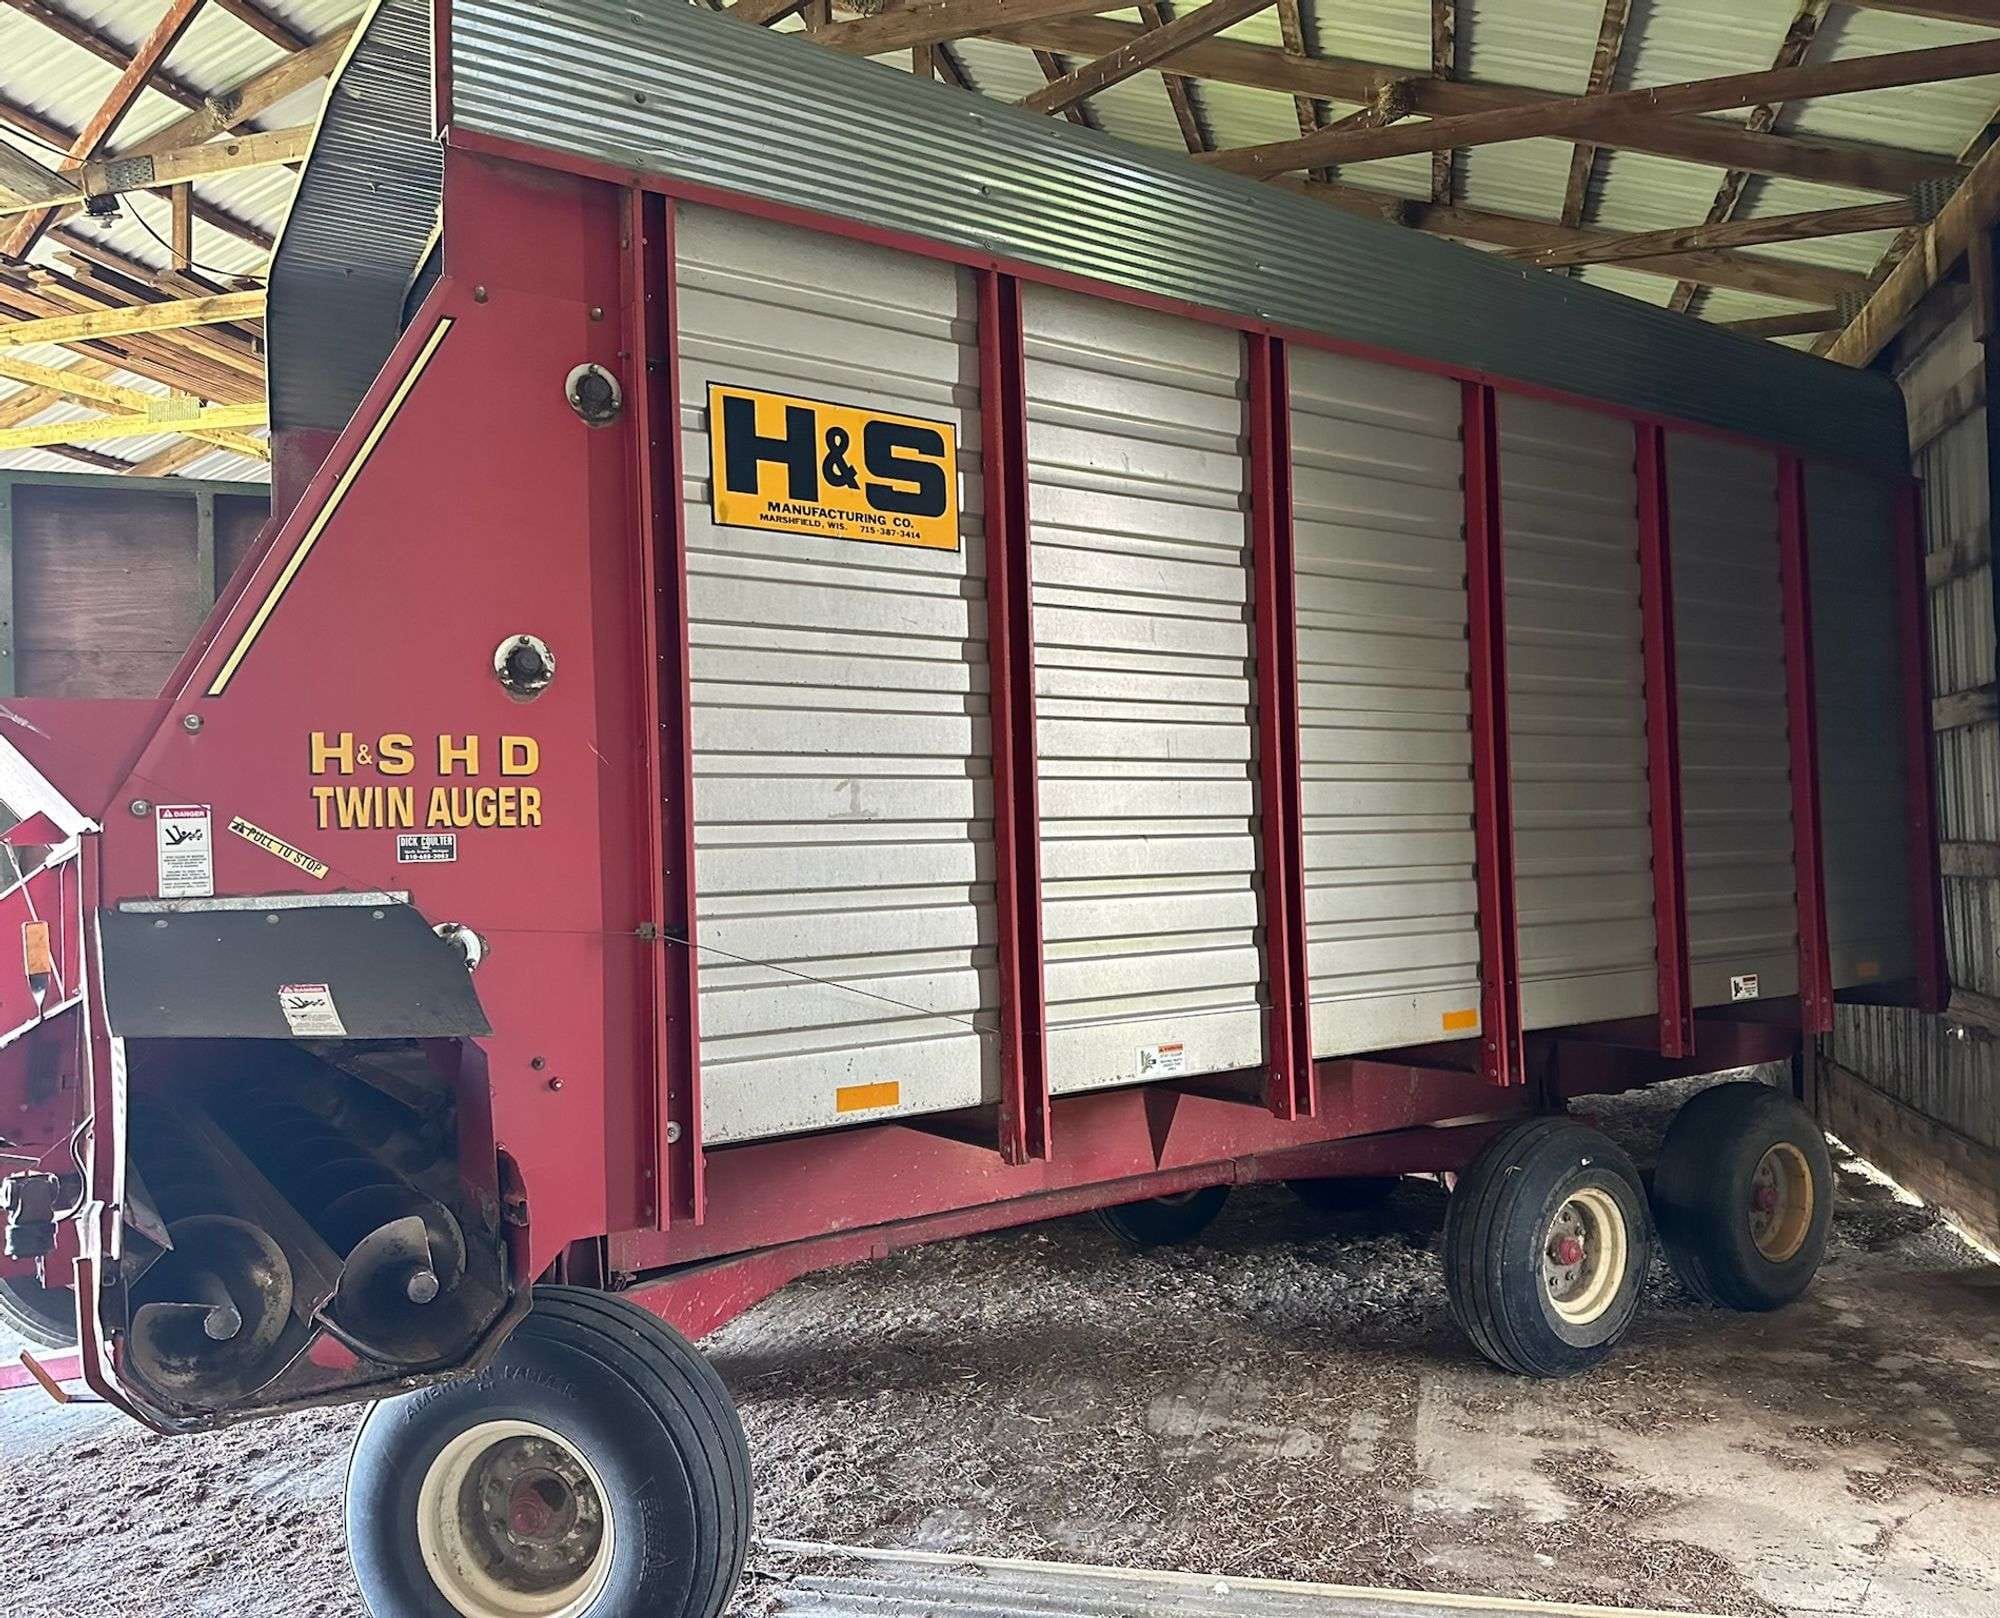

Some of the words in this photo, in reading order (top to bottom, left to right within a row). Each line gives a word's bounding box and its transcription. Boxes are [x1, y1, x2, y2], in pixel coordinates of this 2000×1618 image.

[722, 395, 947, 518] H&S
[759, 513, 825, 529] MARSHFIELD,
[827, 522, 849, 531] WIS.
[859, 526, 921, 540] 715-387-3414
[767, 502, 887, 526] MANUFACTURING
[893, 517, 915, 529] CO.
[310, 732, 415, 775] H&S
[173, 810, 205, 818] DANGER
[312, 786, 415, 829] TWIN
[426, 786, 542, 828] AUGER
[246, 827, 273, 849] PULL
[277, 843, 292, 858] TO
[293, 852, 322, 873] STOP
[400, 837, 419, 847] DICK
[420, 836, 453, 847] COULTER
